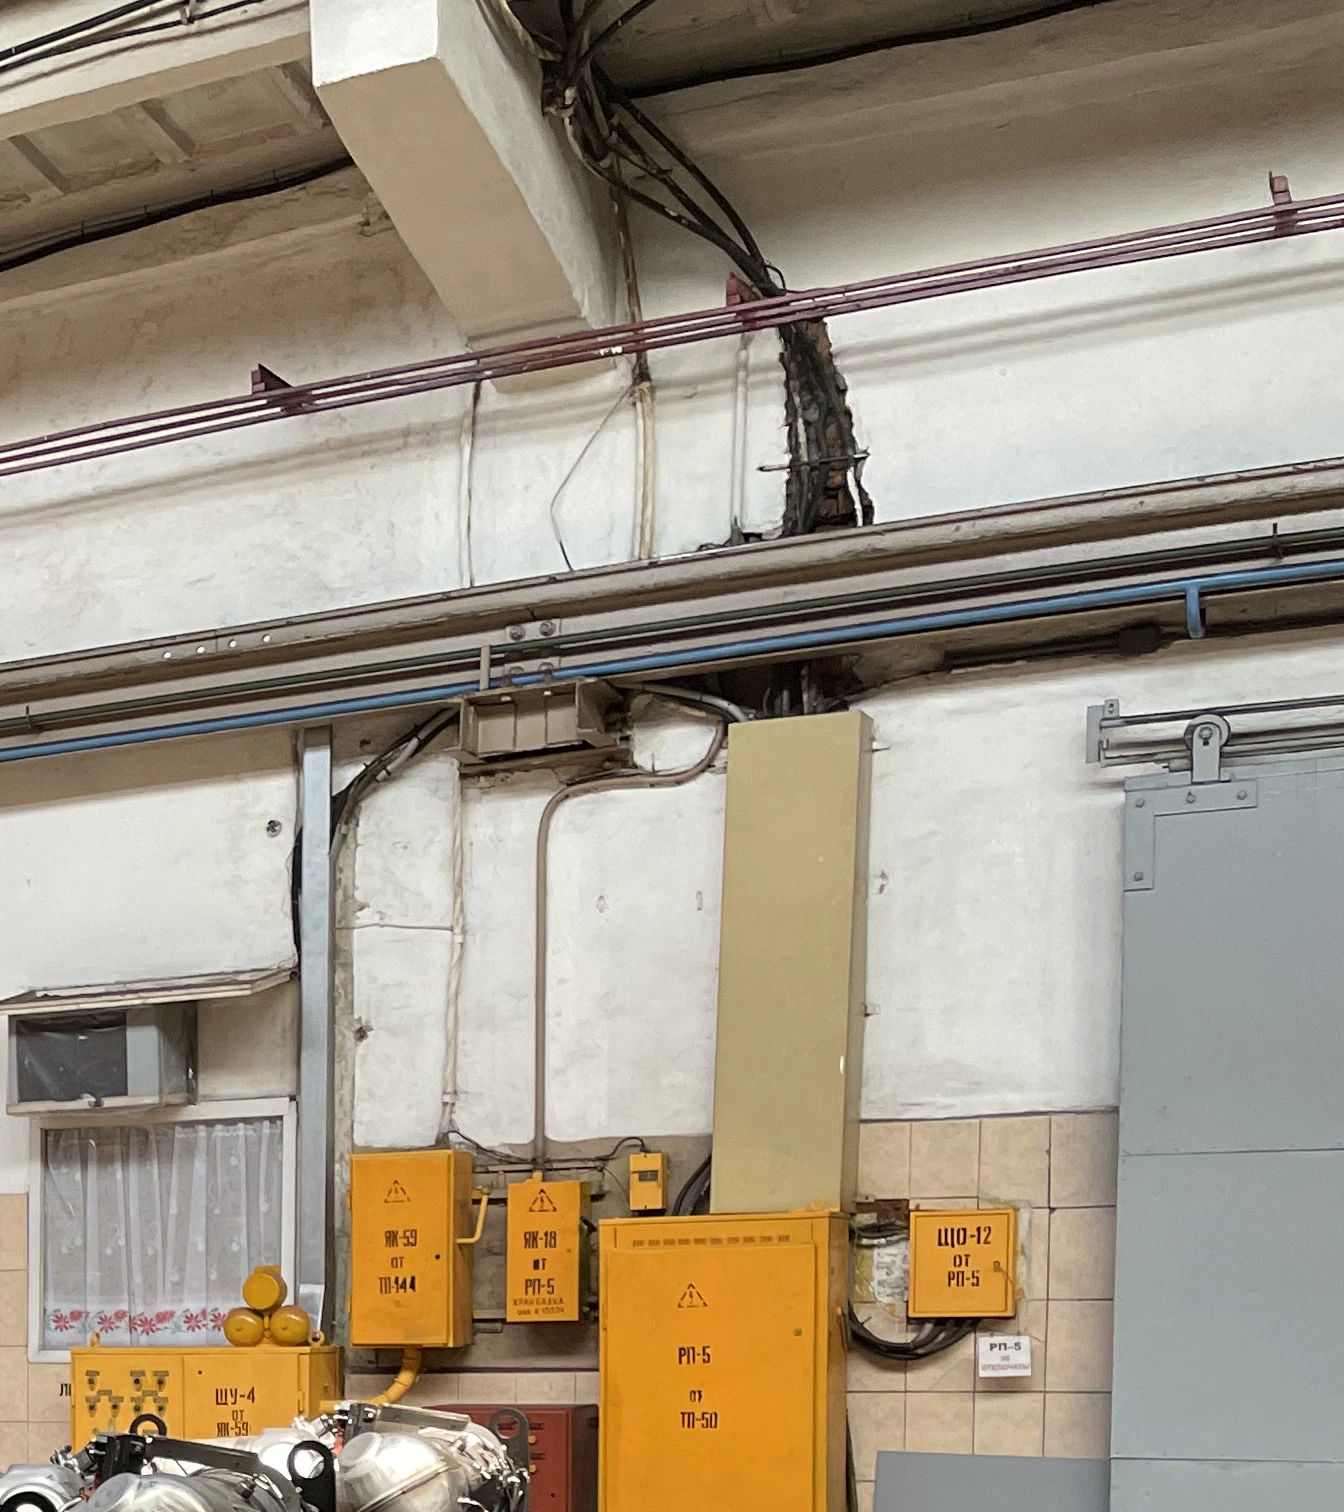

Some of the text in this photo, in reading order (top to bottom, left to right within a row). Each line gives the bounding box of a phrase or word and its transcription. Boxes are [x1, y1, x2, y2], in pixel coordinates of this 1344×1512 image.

[384, 1229, 417, 1248] ЯК-59
[523, 1230, 557, 1249] ЯК-18
[937, 1225, 992, 1248] ЩО-12
[524, 1277, 556, 1296] РП-5
[947, 1269, 980, 1288] РП-5
[678, 1345, 711, 1366] РП-5
[215, 1386, 256, 1406] ЩУ-4
[680, 1411, 719, 1430] ТП-50
